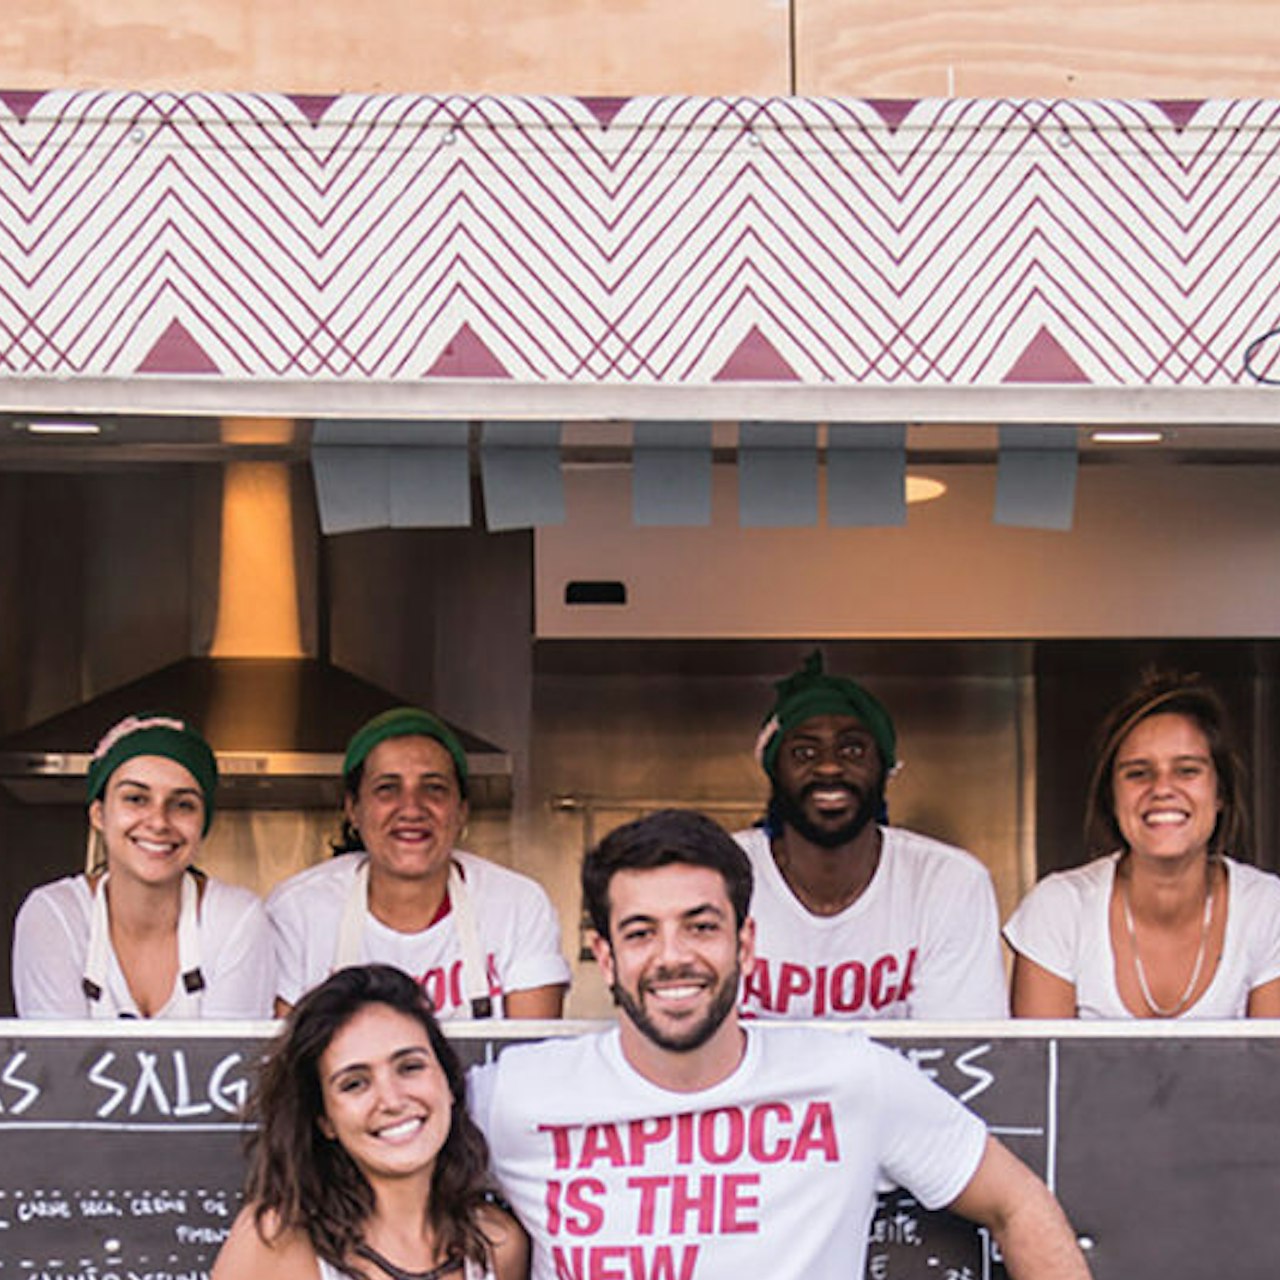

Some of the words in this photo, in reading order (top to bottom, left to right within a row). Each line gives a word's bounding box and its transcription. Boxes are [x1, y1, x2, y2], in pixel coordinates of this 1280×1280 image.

[89, 1051, 250, 1117] SALG
[538, 1101, 839, 1169] TAPIOCA
[546, 1178, 607, 1236] IS
[628, 1173, 761, 1235] THE
[870, 1255, 890, 1280] E
